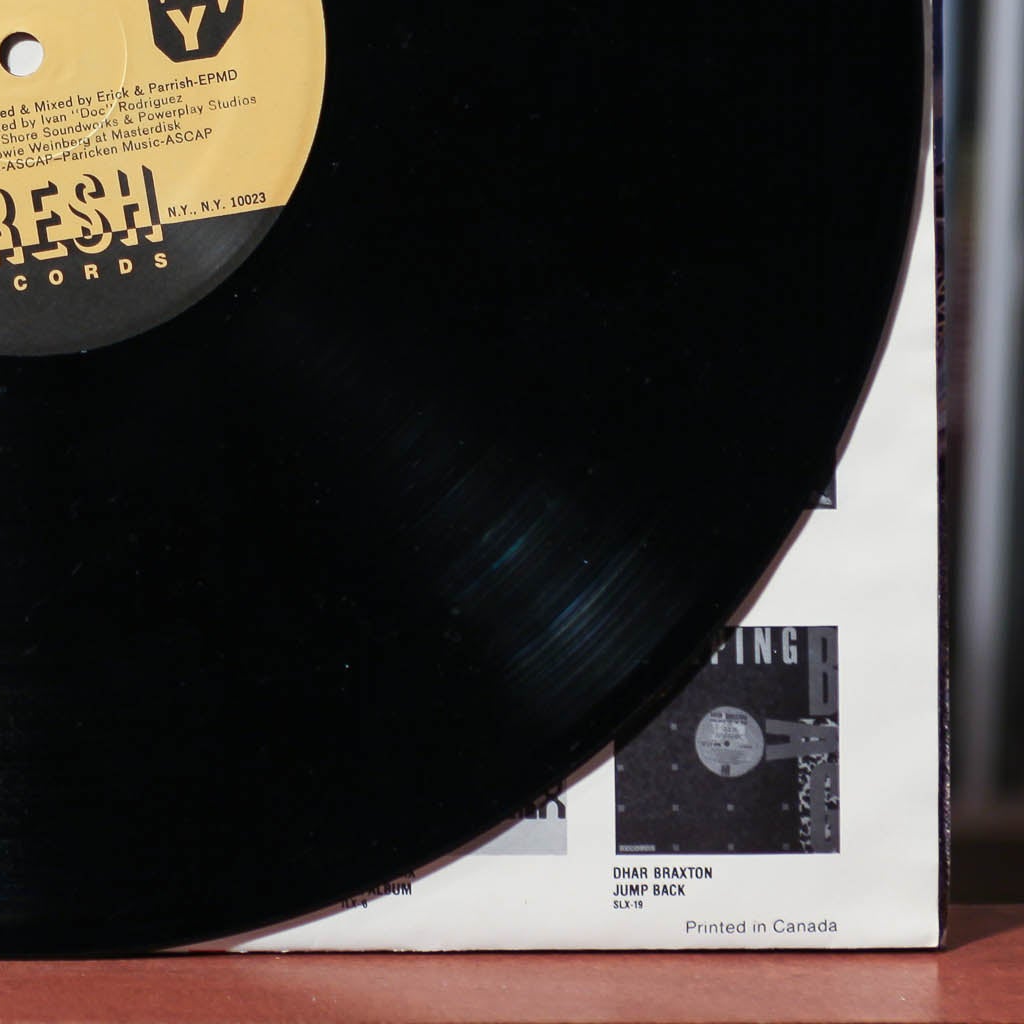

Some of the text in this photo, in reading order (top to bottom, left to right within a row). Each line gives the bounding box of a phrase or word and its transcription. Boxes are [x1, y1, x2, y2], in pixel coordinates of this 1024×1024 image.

[19, 103, 30, 118] &
[33, 95, 73, 114] Mixed
[76, 93, 92, 108] by
[96, 85, 129, 104] Erick
[133, 84, 144, 96] &
[148, 68, 237, 94] Parrish-EPMD
[0, 128, 38, 144] Shore
[42, 118, 118, 138] Soundworks
[123, 113, 134, 124] &
[137, 103, 203, 122] Powerplay
[208, 95, 256, 110] Studios
[20, 116, 35, 128] by
[40, 113, 67, 125] Ivan
[117, 94, 183, 112] Rodriguez
[28, 136, 90, 155] Weinberg
[95, 131, 107, 146] at
[111, 119, 181, 140] Masterdisk
[121, 127, 212, 152] Music-ASCAP
[200, 198, 226, 212] N.Y.
[229, 191, 266, 207] 10023
[613, 866, 713, 879] DHAR BRAXTON
[613, 883, 686, 896] JUMP BACK
[613, 900, 644, 909] SLX-19
[685, 919, 838, 934] Printed in Canada
